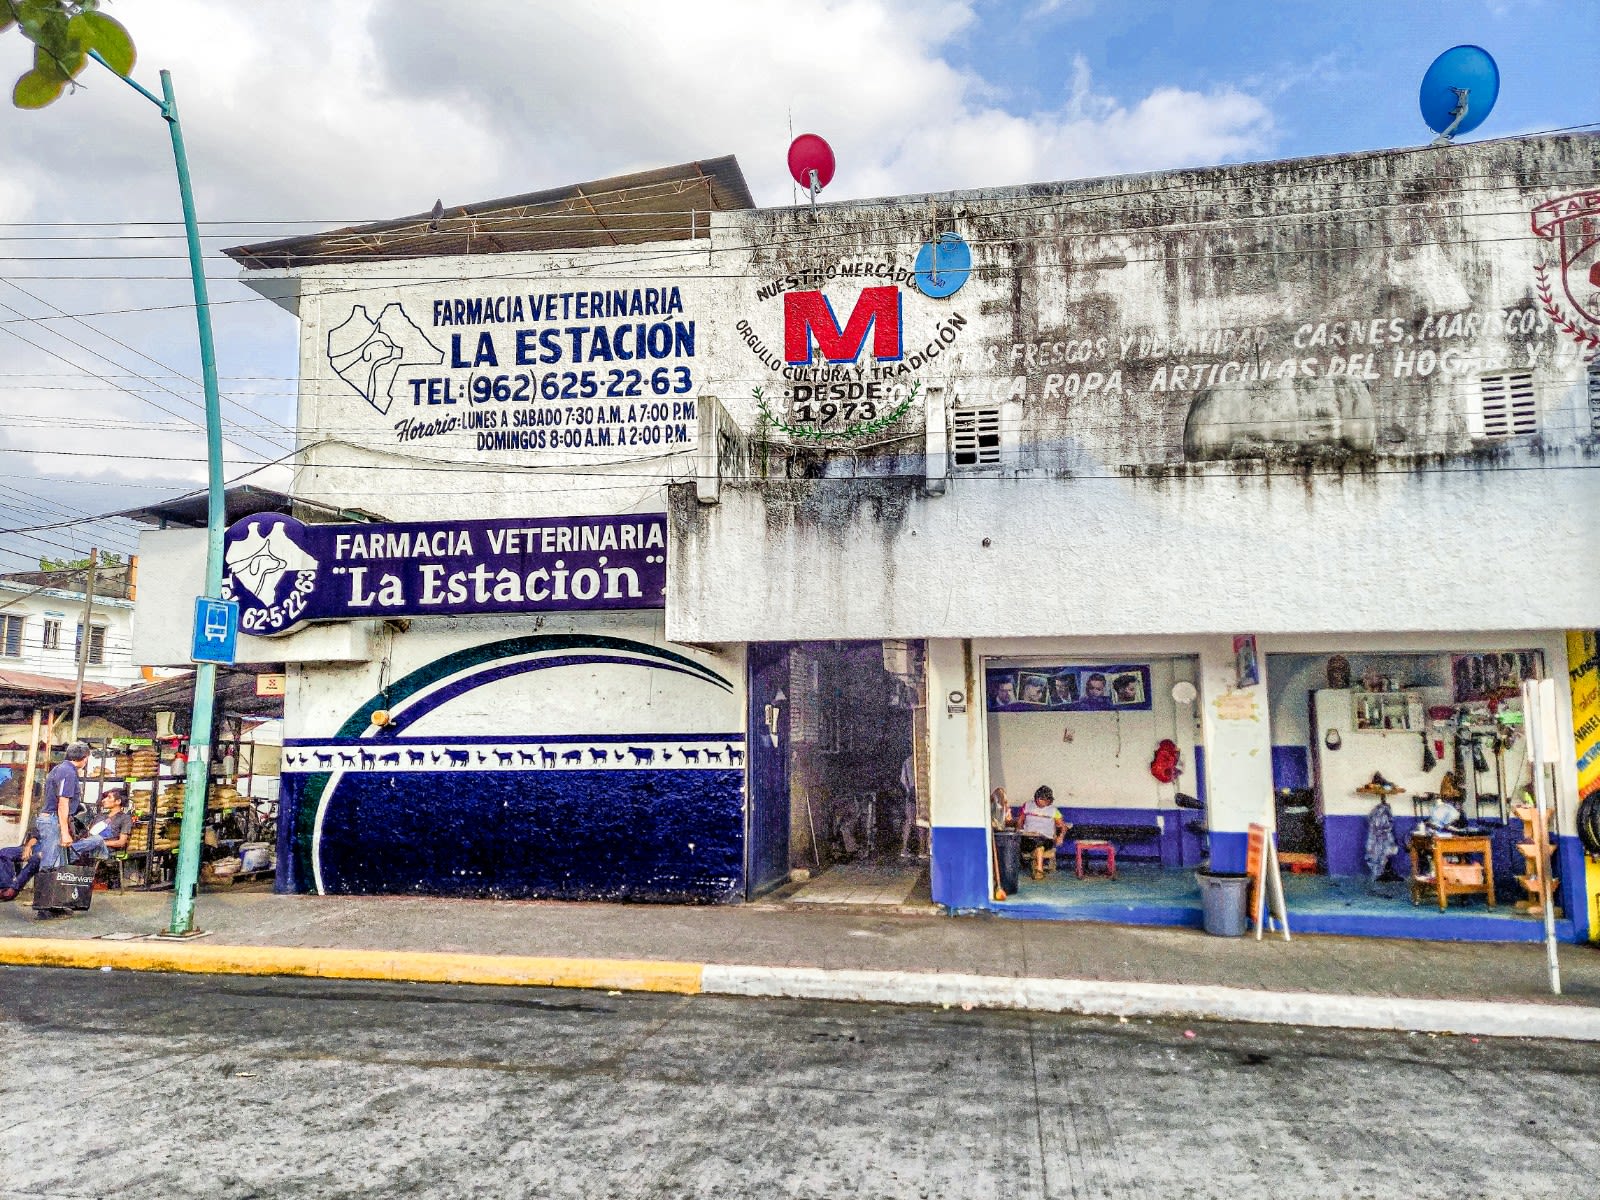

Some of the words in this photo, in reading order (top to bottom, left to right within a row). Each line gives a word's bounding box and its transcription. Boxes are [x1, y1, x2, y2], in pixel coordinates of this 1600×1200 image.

[756, 265, 837, 301] NUESTRO
[433, 295, 523, 327] FARMACIA
[528, 286, 683, 322] VETERINARIA
[784, 285, 903, 365] M
[451, 332, 499, 369] LA
[515, 314, 695, 367] ESTACIÓN
[735, 319, 782, 371] ORGULLO
[783, 366, 851, 382] CULTURA
[855, 368, 865, 381] Y
[872, 311, 968, 380] TRADICIÓN
[1326, 353, 1381, 379] DEL
[793, 382, 882, 402] DESDE
[394, 413, 461, 442] Horario:
[462, 410, 497, 429] LUNES
[501, 410, 508, 428] A
[513, 407, 562, 428] SABADO
[565, 406, 594, 426] 7:30
[597, 405, 625, 425] A.M.
[627, 404, 637, 423] A
[640, 402, 669, 422] 7:00
[673, 401, 698, 421] P.M.
[796, 402, 876, 424] 1973
[477, 429, 546, 451] DOMINGOS
[550, 428, 582, 448] 8:00
[584, 427, 615, 447] A.M.
[617, 426, 626, 446] A
[629, 425, 661, 445] 2:00
[665, 423, 691, 444] P.M.
[335, 530, 474, 560] FARMACIA
[486, 523, 665, 555] VETERINARIA
